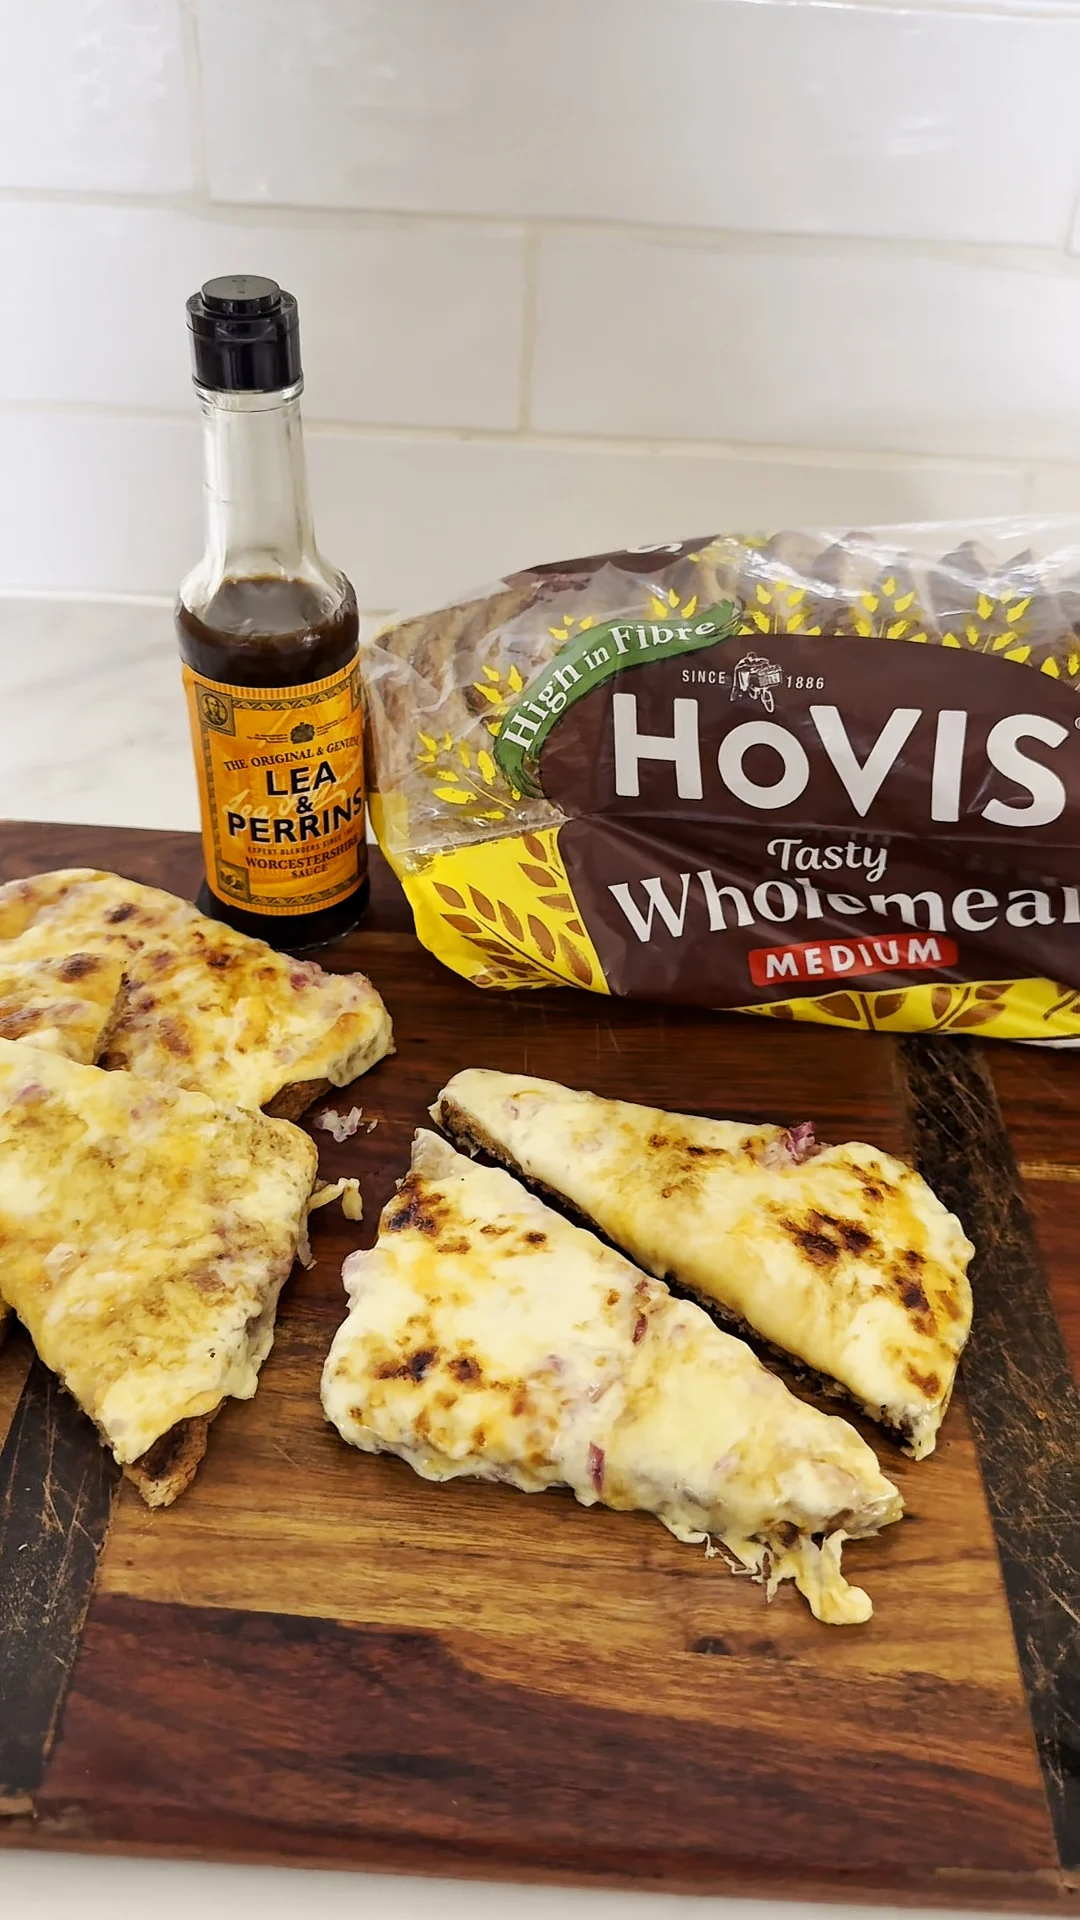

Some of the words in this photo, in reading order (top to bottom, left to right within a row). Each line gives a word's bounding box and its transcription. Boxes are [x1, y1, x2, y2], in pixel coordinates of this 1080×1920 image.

[503, 664, 582, 751] High
[584, 646, 610, 671] in
[609, 619, 717, 656] Fibre
[681, 669, 727, 685] SINCE
[785, 675, 826, 690] 1886
[223, 758, 248, 772] THE
[251, 749, 315, 767] ORIGINAL
[316, 747, 325, 757] &
[267, 761, 337, 796] LEA
[228, 788, 363, 844] PERRINS
[296, 796, 313, 816] &
[246, 834, 359, 870] WORCESTERSHIRE
[766, 838, 888, 883] Tasty
[291, 863, 329, 879] SAUCE
[766, 936, 943, 979] MEDIUM
